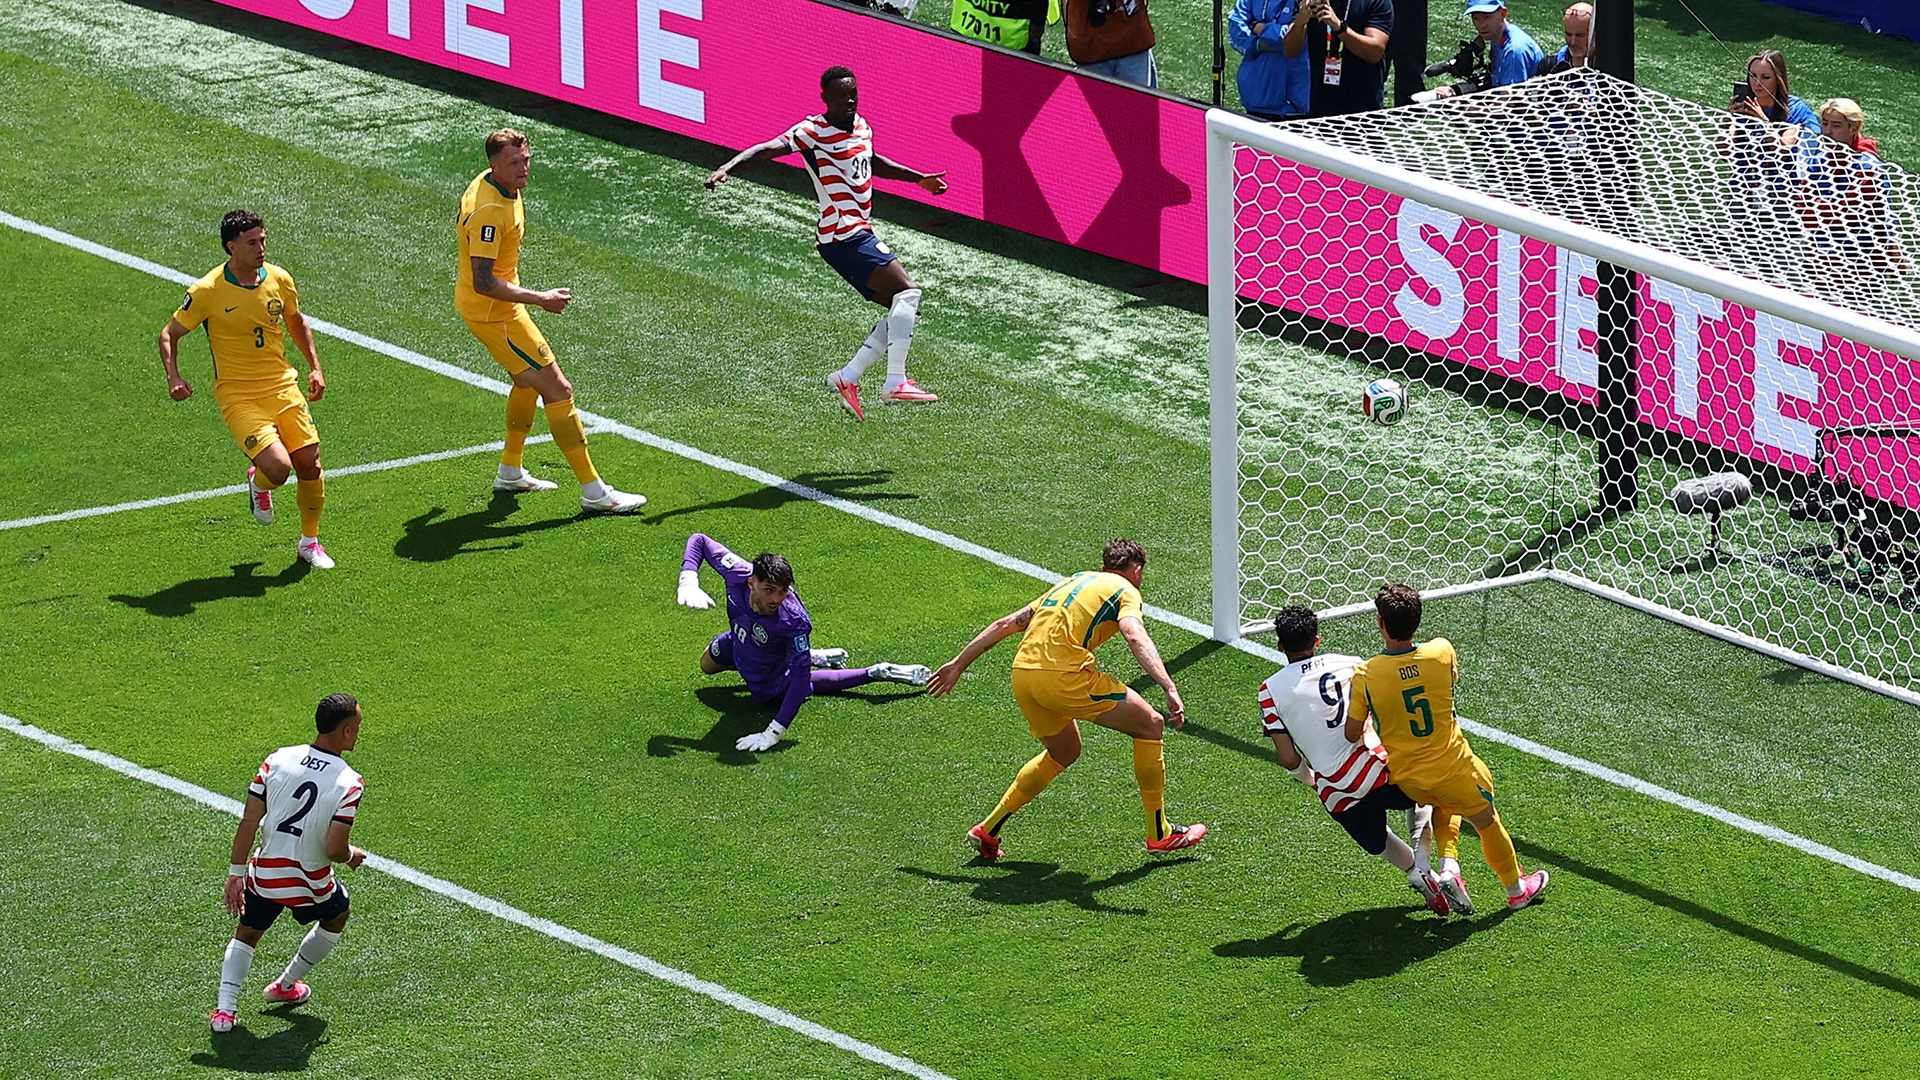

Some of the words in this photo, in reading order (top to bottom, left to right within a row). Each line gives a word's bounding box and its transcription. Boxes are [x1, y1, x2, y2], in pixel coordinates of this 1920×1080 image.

[961, 11, 1001, 41] 17011
[852, 157, 868, 179] 20
[253, 326, 265, 348] 3
[1399, 664, 1420, 681] BOS
[1318, 672, 1345, 729] 9
[1401, 685, 1434, 738] 5
[300, 755, 331, 773] DEST
[276, 780, 319, 838] 2
